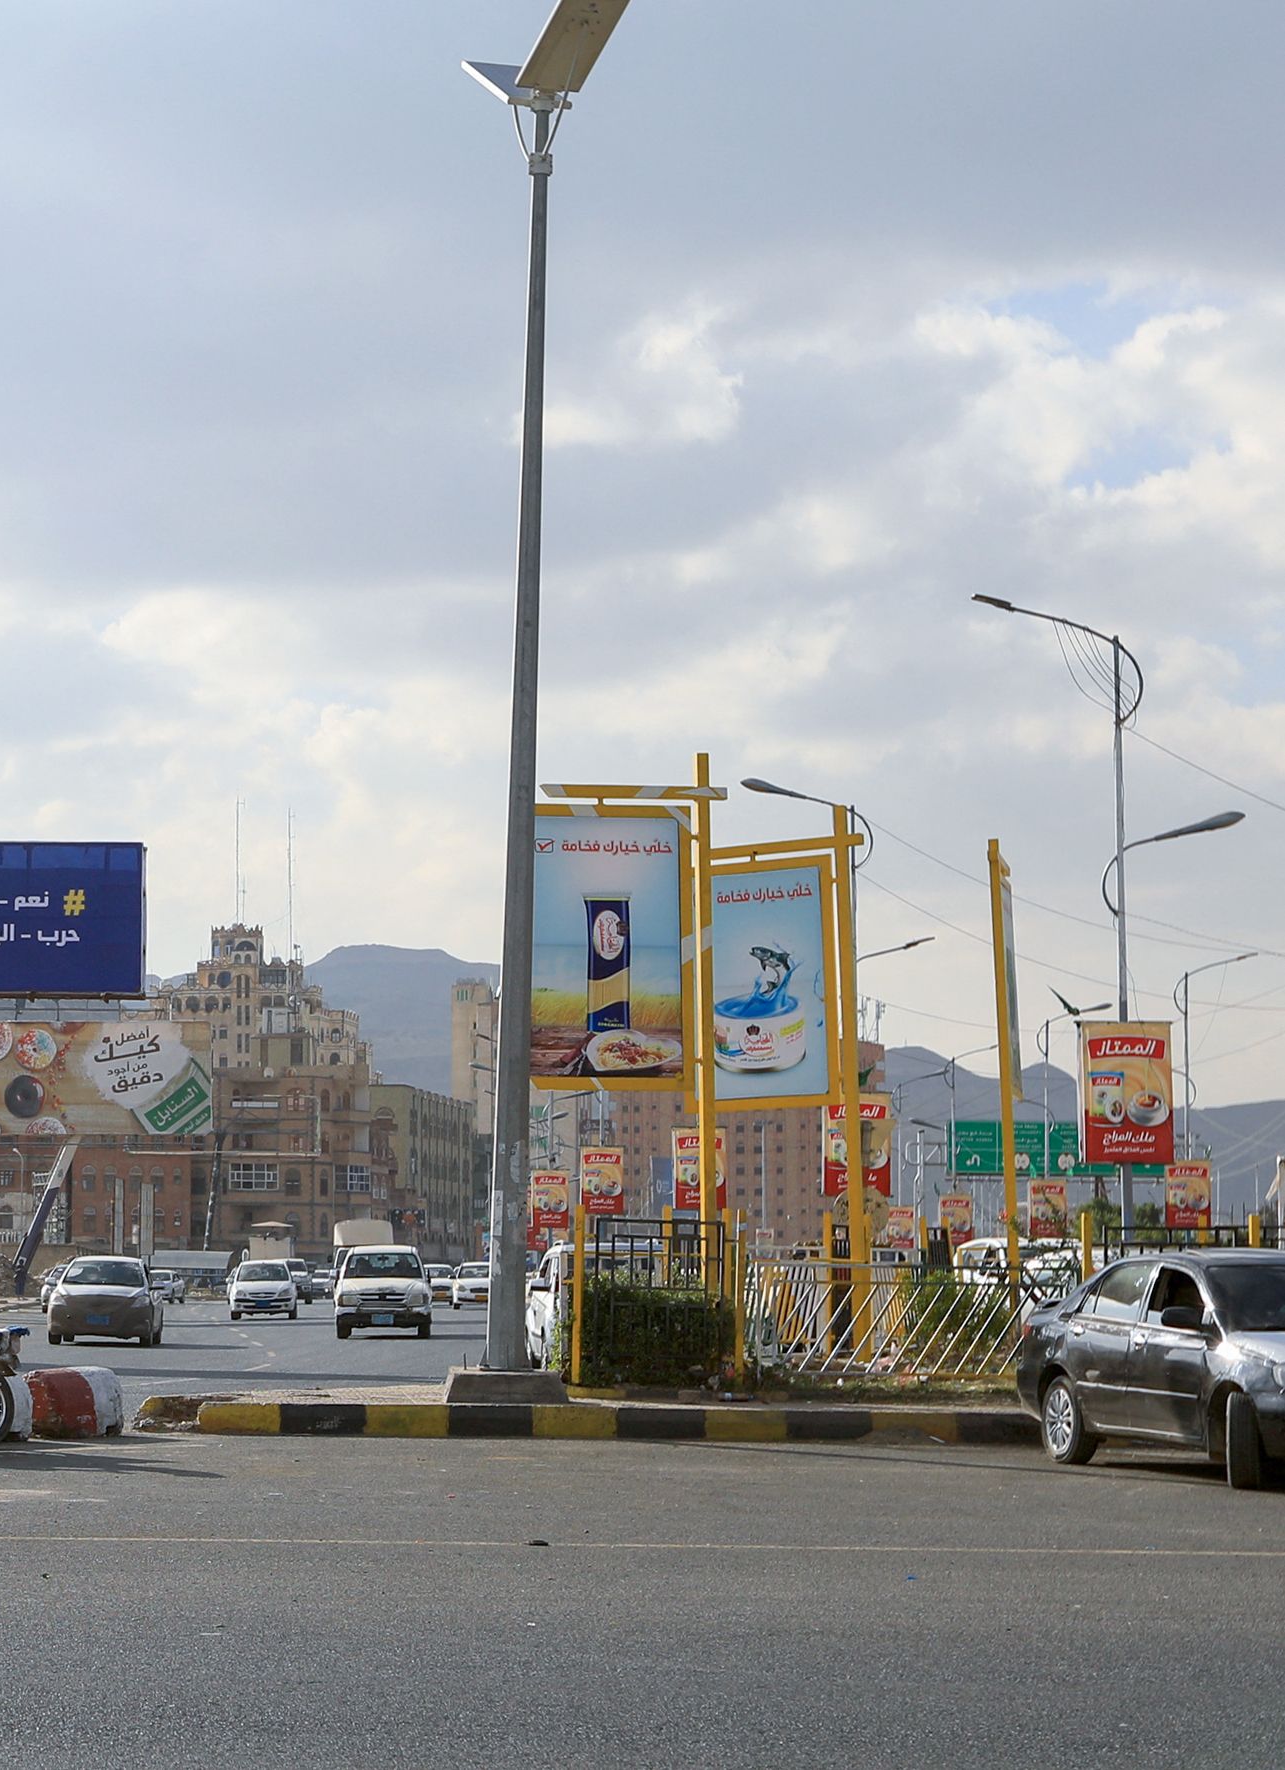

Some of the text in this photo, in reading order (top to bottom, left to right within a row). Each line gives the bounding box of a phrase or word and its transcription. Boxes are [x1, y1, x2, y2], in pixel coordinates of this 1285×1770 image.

[561, 839, 600, 852] فخامة
[603, 839, 640, 856] خيارك
[14, 890, 50, 911] نعم
[717, 888, 750, 903] فخامة
[752, 886, 784, 903] خيارك
[37, 929, 80, 947] حرب
[115, 1025, 149, 1046] أفضل
[94, 1034, 160, 1062] كيك
[1097, 1039, 1156, 1056] الممتاز
[132, 1063, 148, 1073] من
[112, 1071, 163, 1093] دقيق
[156, 1086, 199, 1126] السنابل
